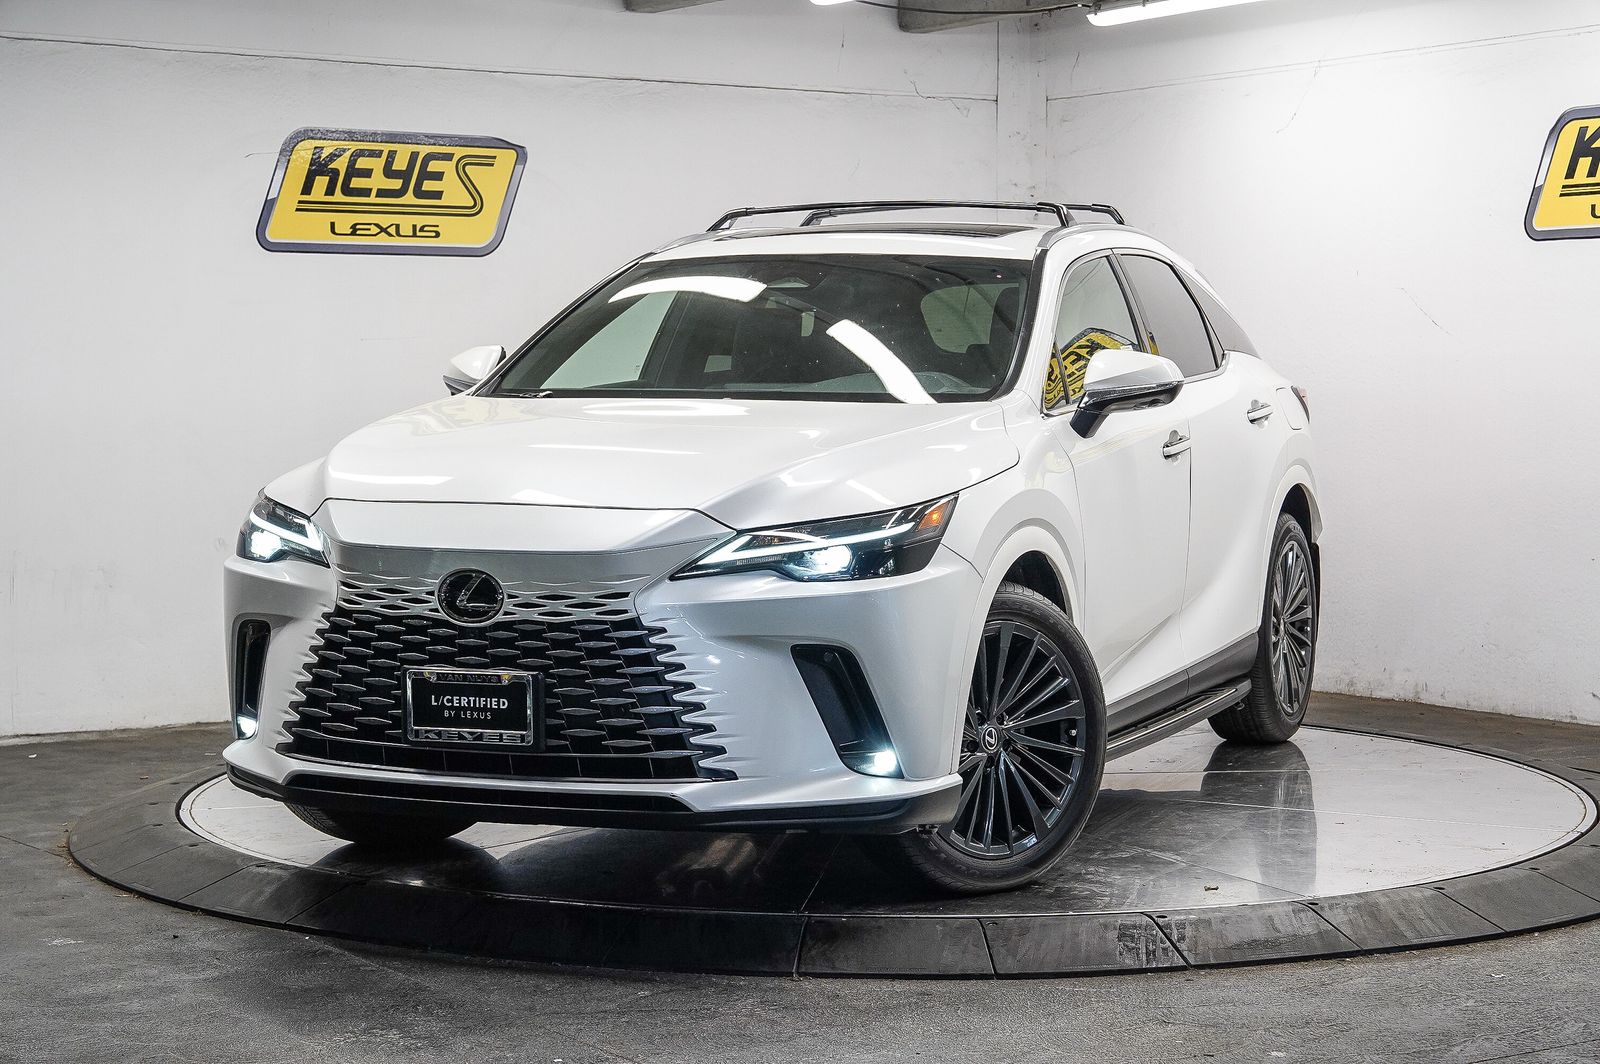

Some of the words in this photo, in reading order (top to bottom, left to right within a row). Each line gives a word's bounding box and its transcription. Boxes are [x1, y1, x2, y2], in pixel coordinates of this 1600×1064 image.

[295, 146, 496, 217] KEYES
[330, 221, 440, 239] LEXUS
[431, 695, 508, 709] L/CERTIFIED
[461, 711, 492, 720] LEXUS
[419, 730, 521, 743] KEYES
